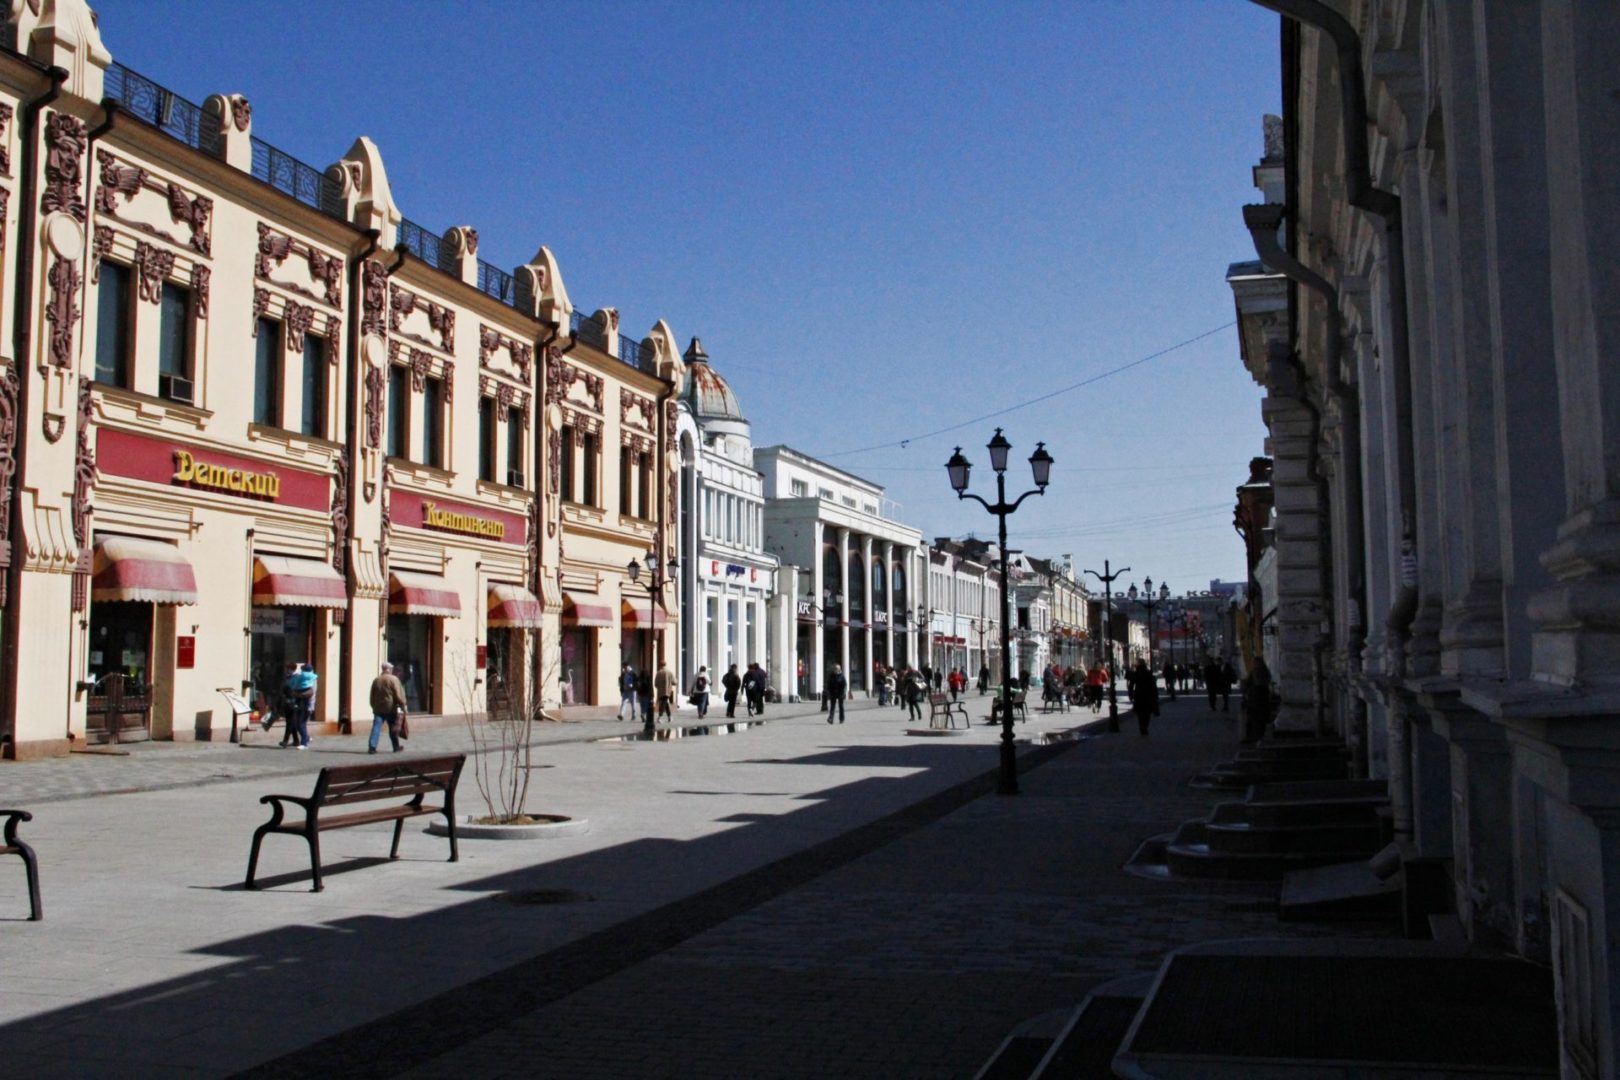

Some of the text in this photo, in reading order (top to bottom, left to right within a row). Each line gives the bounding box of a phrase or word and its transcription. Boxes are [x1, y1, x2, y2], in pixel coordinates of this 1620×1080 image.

[173, 450, 280, 497] Детский
[423, 501, 505, 537] Континент
[798, 601, 811, 615] KFC
